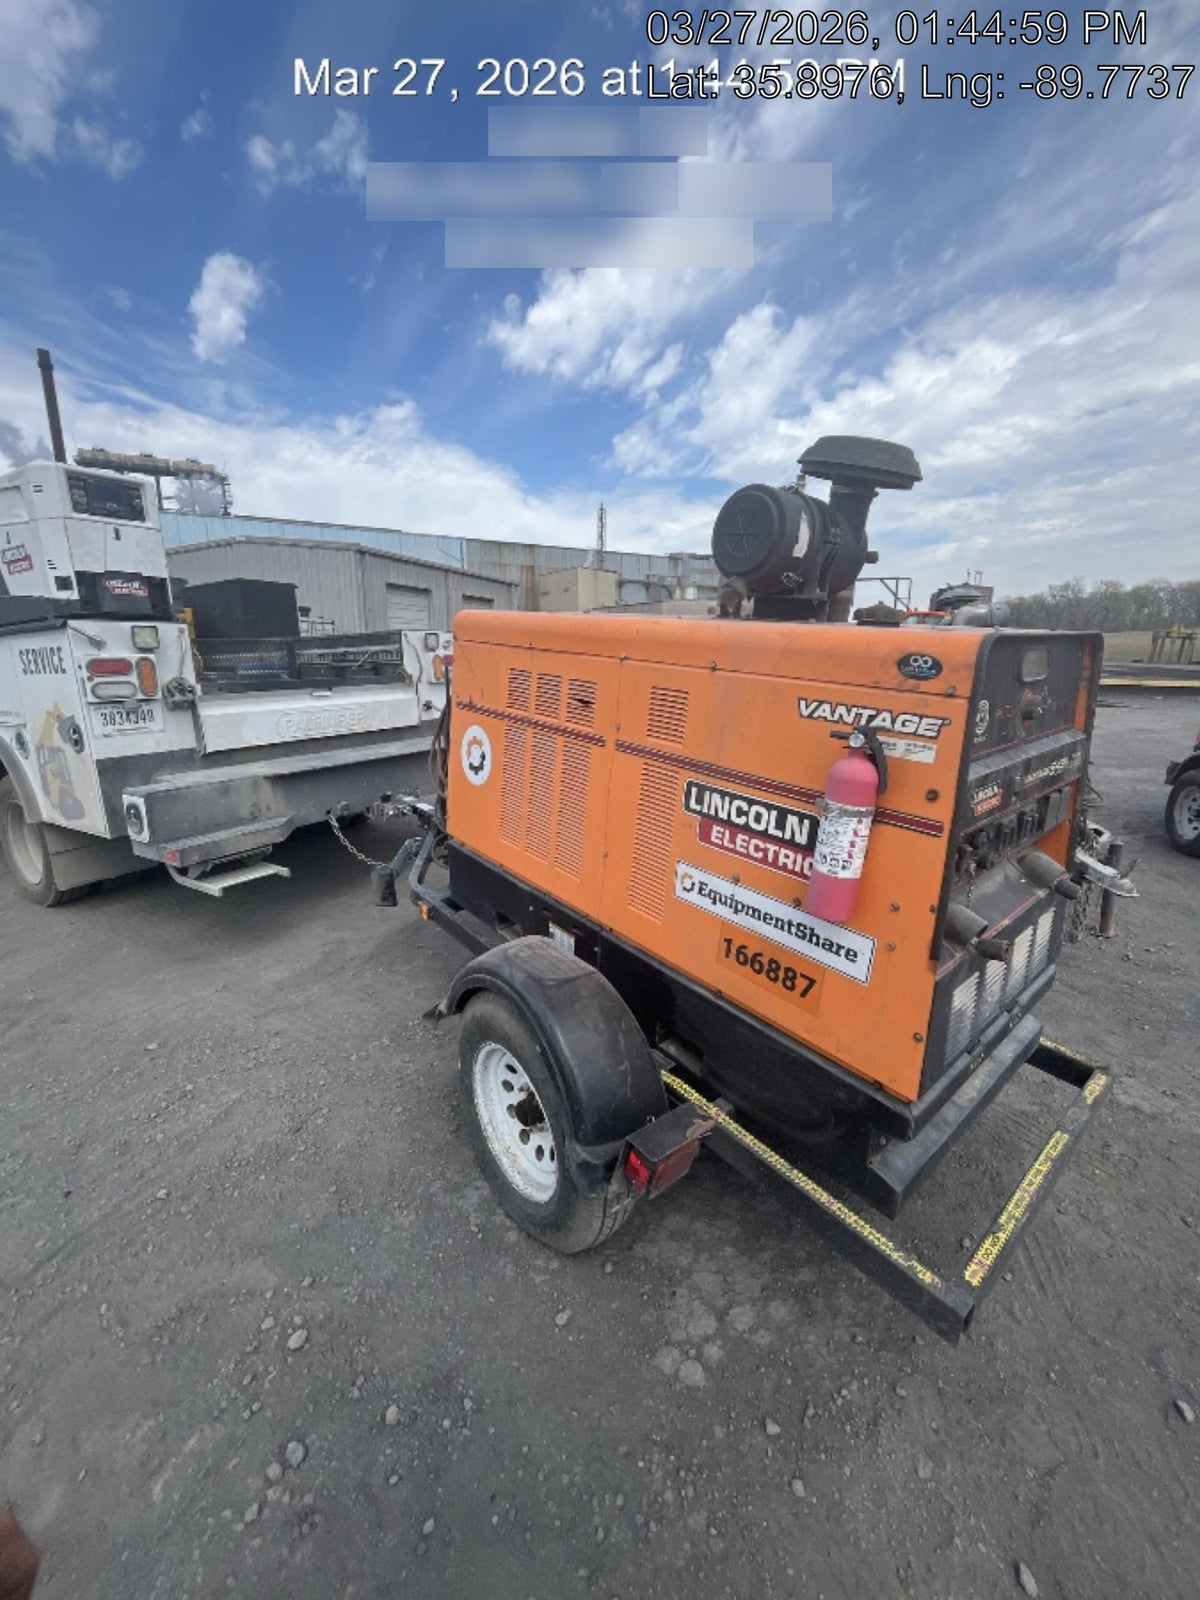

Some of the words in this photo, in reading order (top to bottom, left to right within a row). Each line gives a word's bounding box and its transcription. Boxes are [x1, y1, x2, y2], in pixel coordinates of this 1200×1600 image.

[19, 646, 67, 675] SERVICE
[797, 698, 944, 739] VANTAGE
[688, 786, 810, 846] LINCOLN
[697, 879, 858, 964] EquipmentShare
[723, 937, 816, 998] 166887
